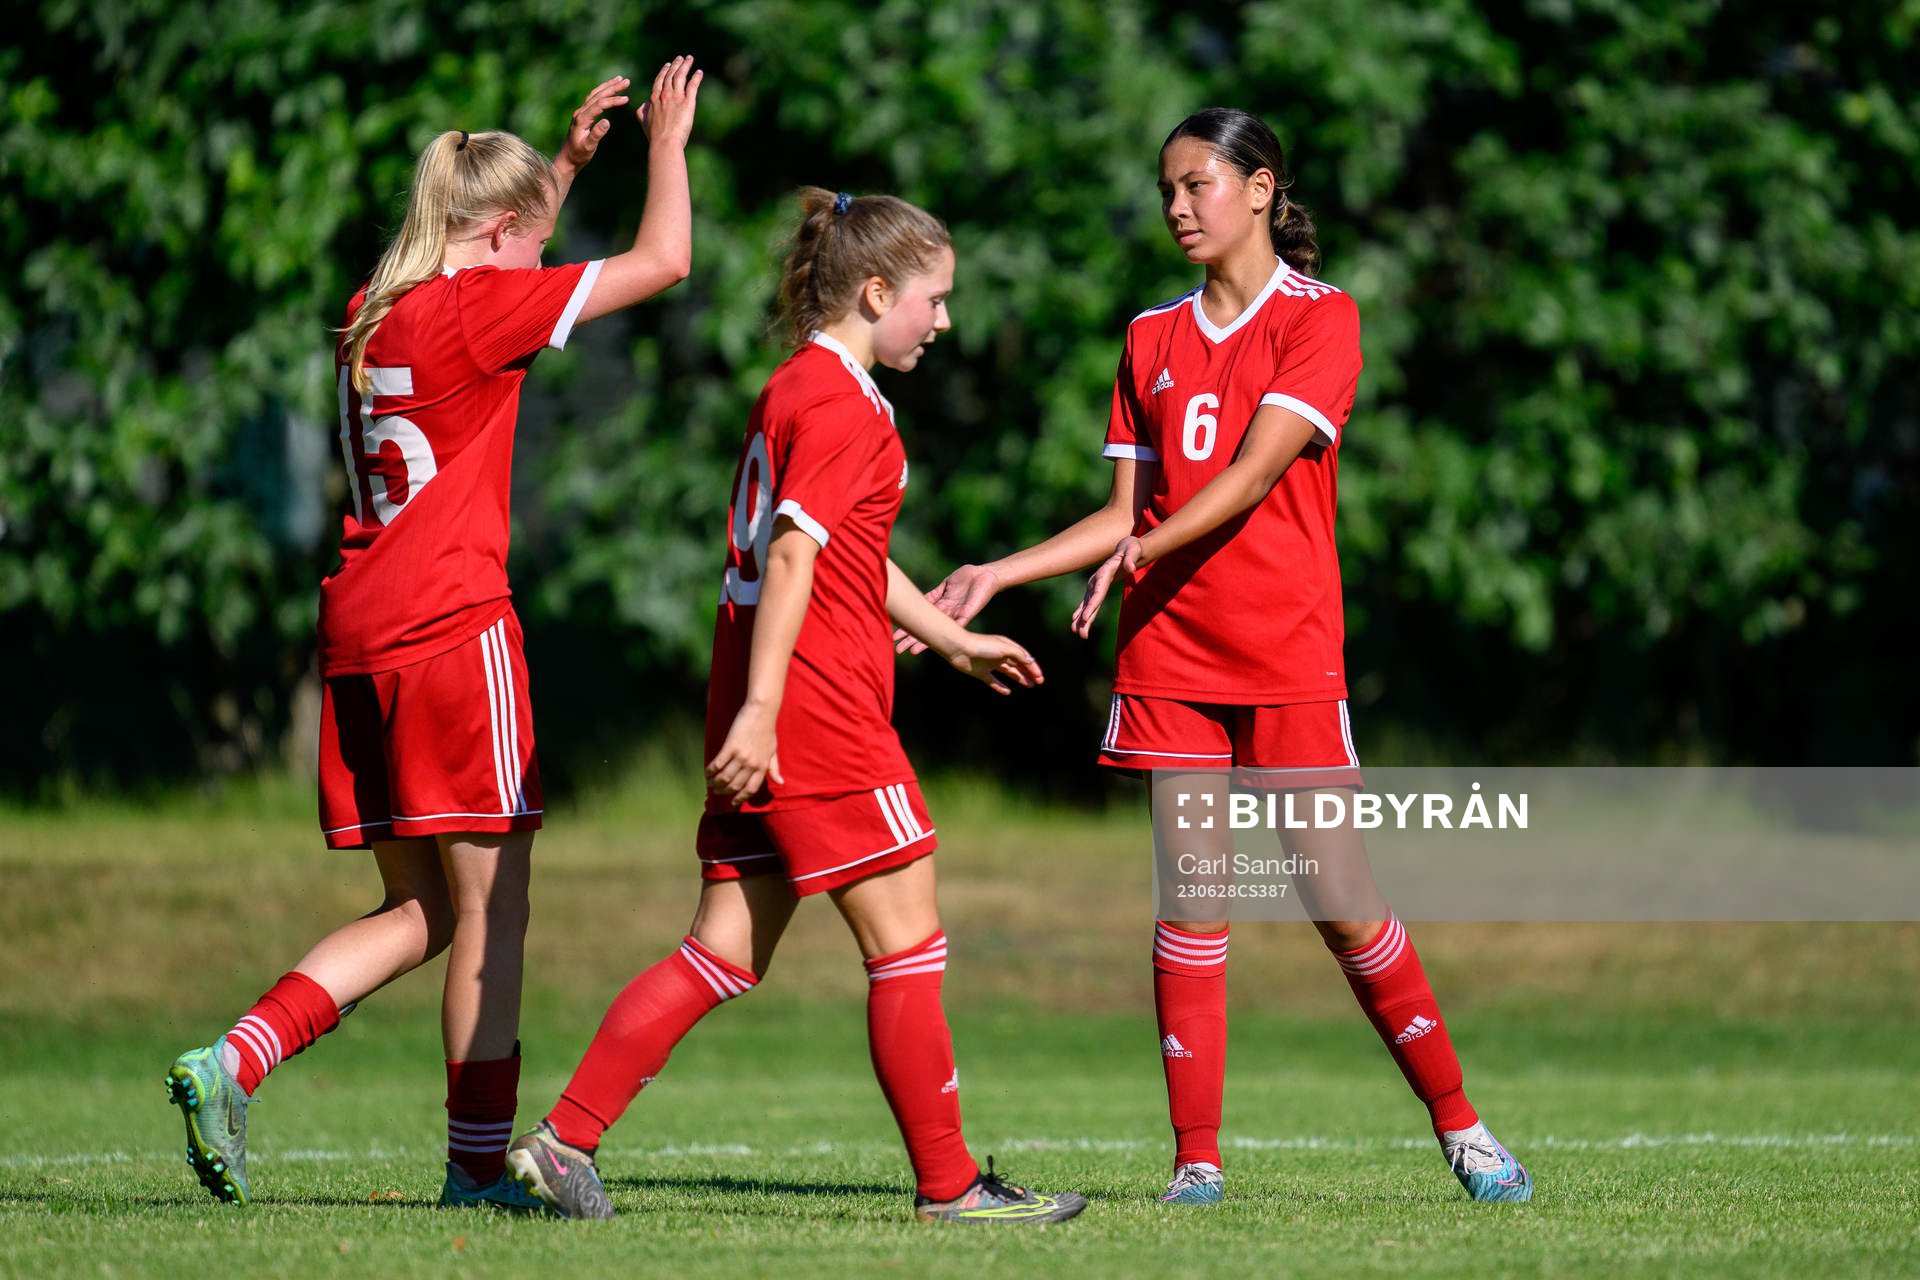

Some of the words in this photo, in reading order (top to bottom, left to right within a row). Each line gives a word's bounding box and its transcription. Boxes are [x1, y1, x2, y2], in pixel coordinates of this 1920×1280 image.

[1151, 379, 1175, 395] adidas
[338, 365, 438, 527] 15
[1182, 392, 1220, 461] 6
[718, 431, 773, 605] 9
[1395, 1020, 1437, 1044] adidas
